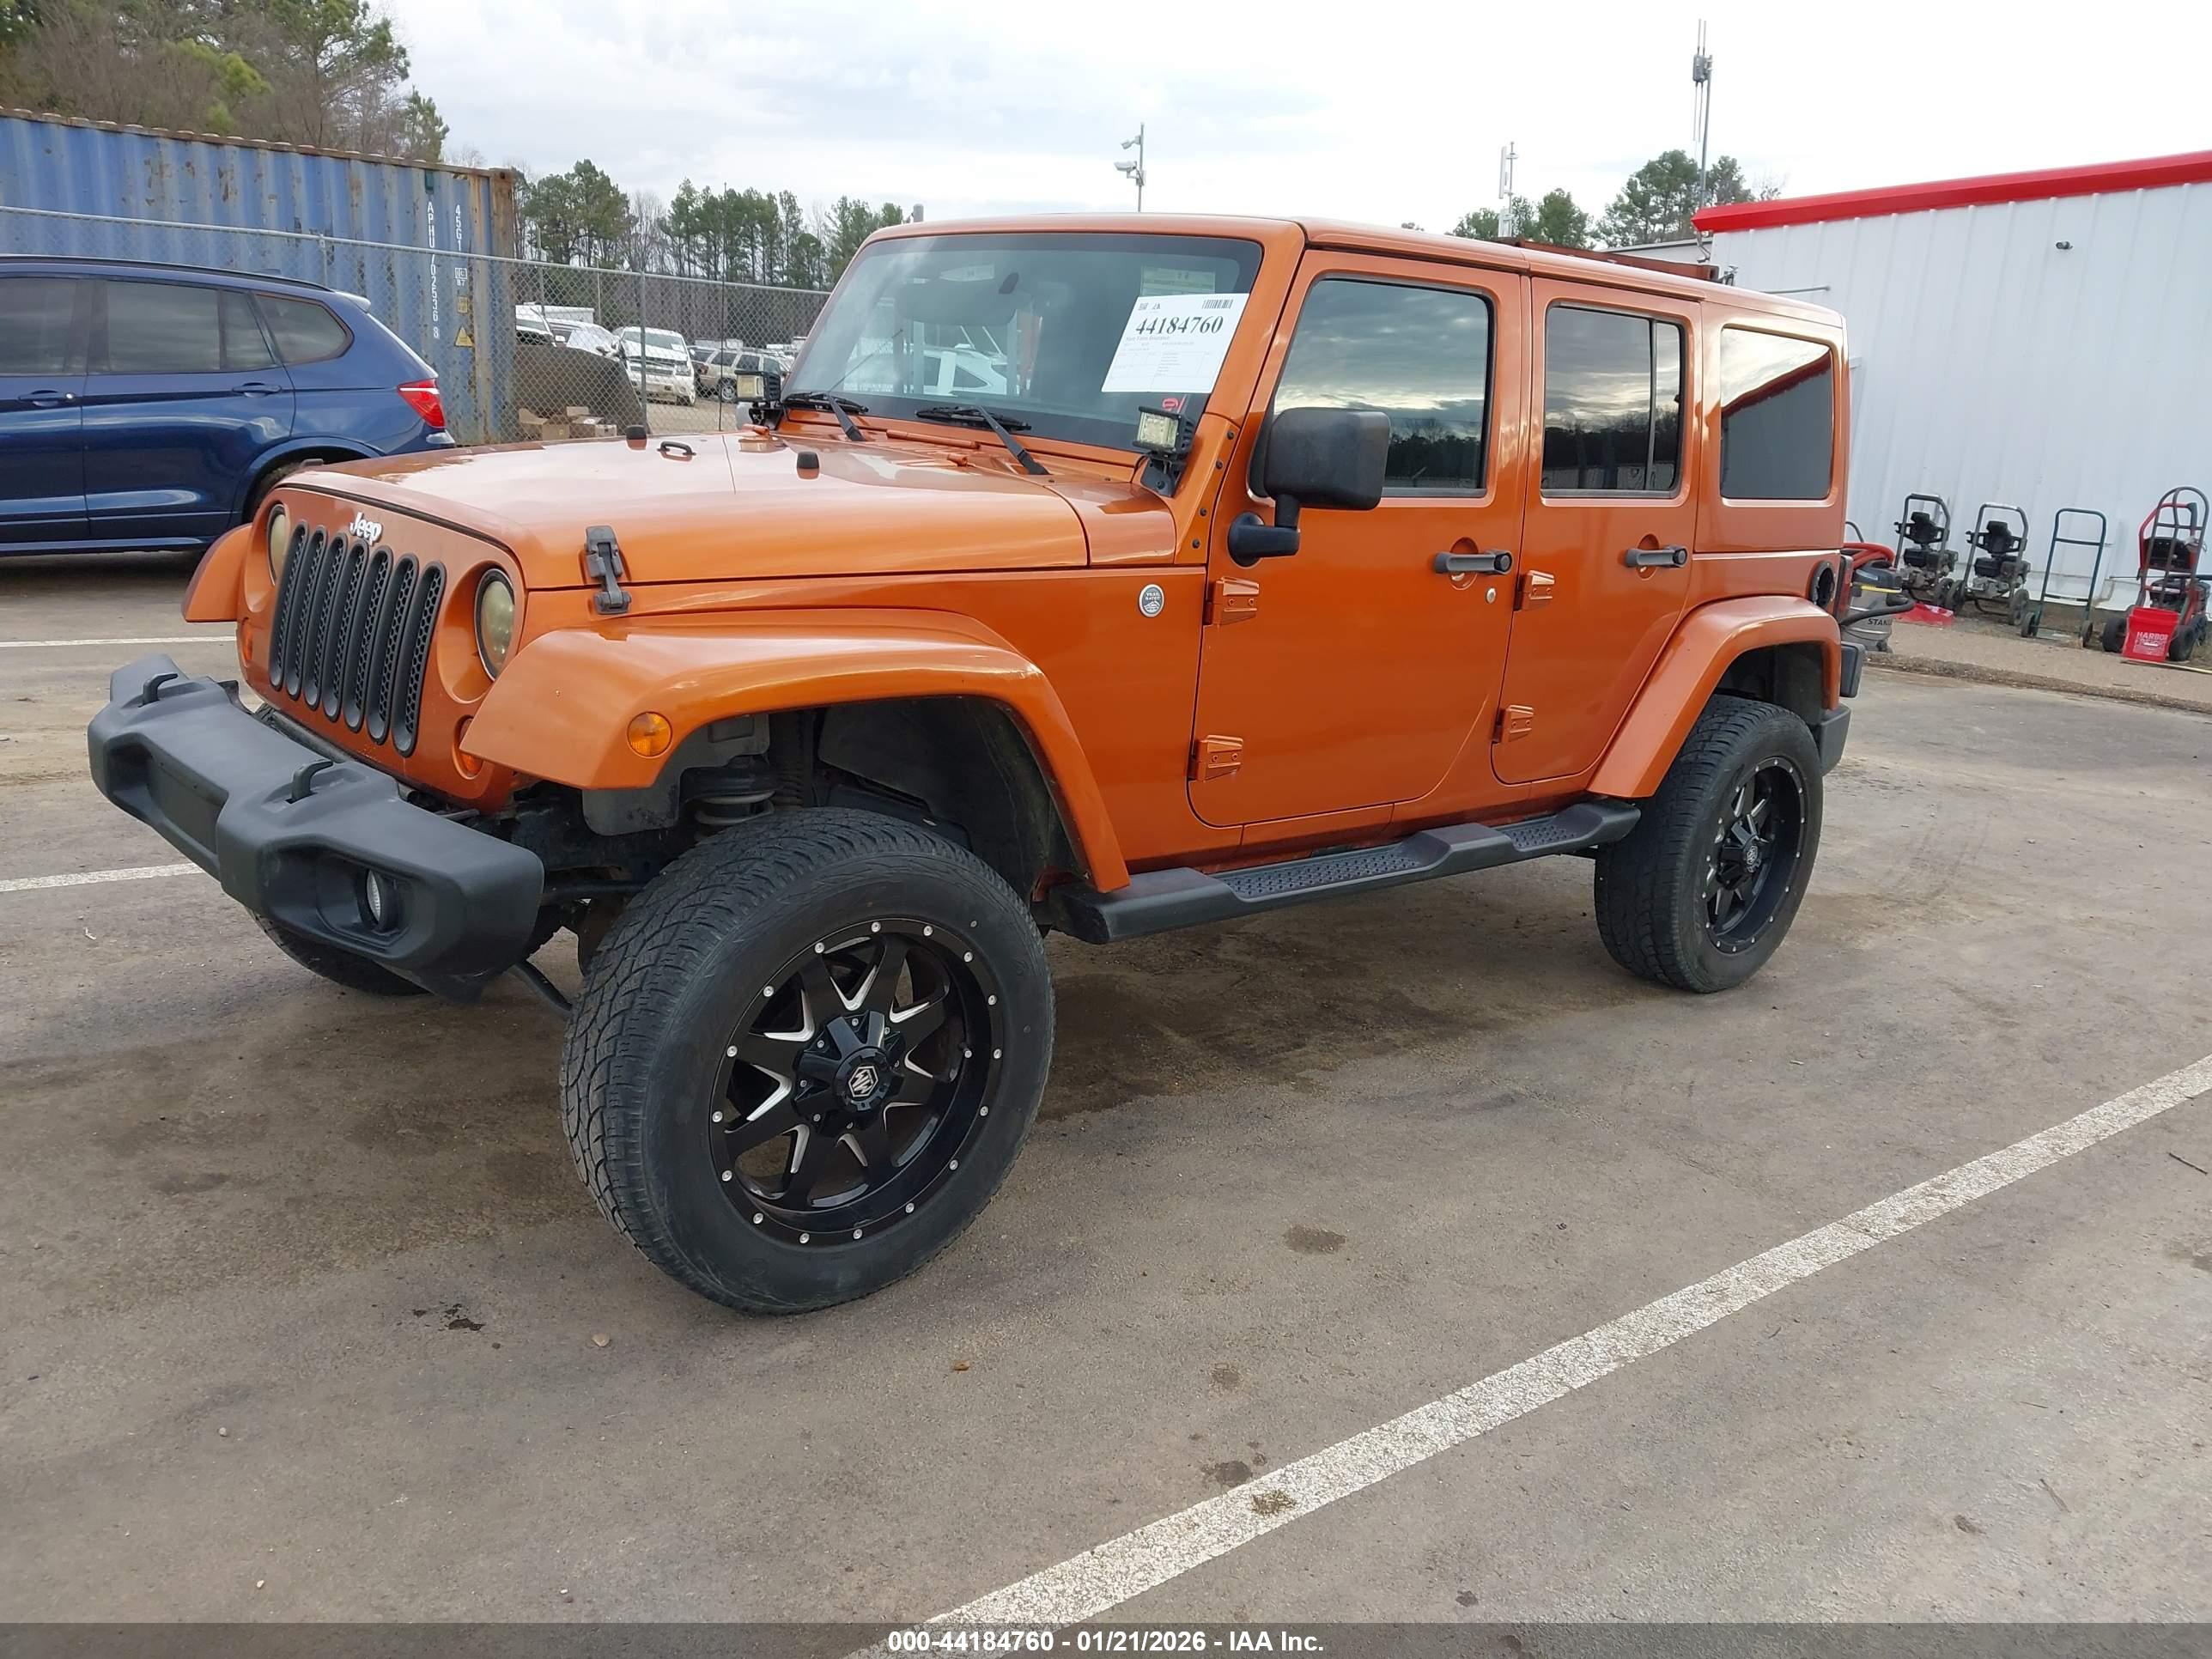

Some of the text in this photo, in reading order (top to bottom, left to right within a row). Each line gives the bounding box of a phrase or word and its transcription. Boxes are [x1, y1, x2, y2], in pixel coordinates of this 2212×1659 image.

[427, 201, 435, 249] APHU
[1135, 315, 1224, 335] 44184760
[349, 512, 382, 546] Jeep
